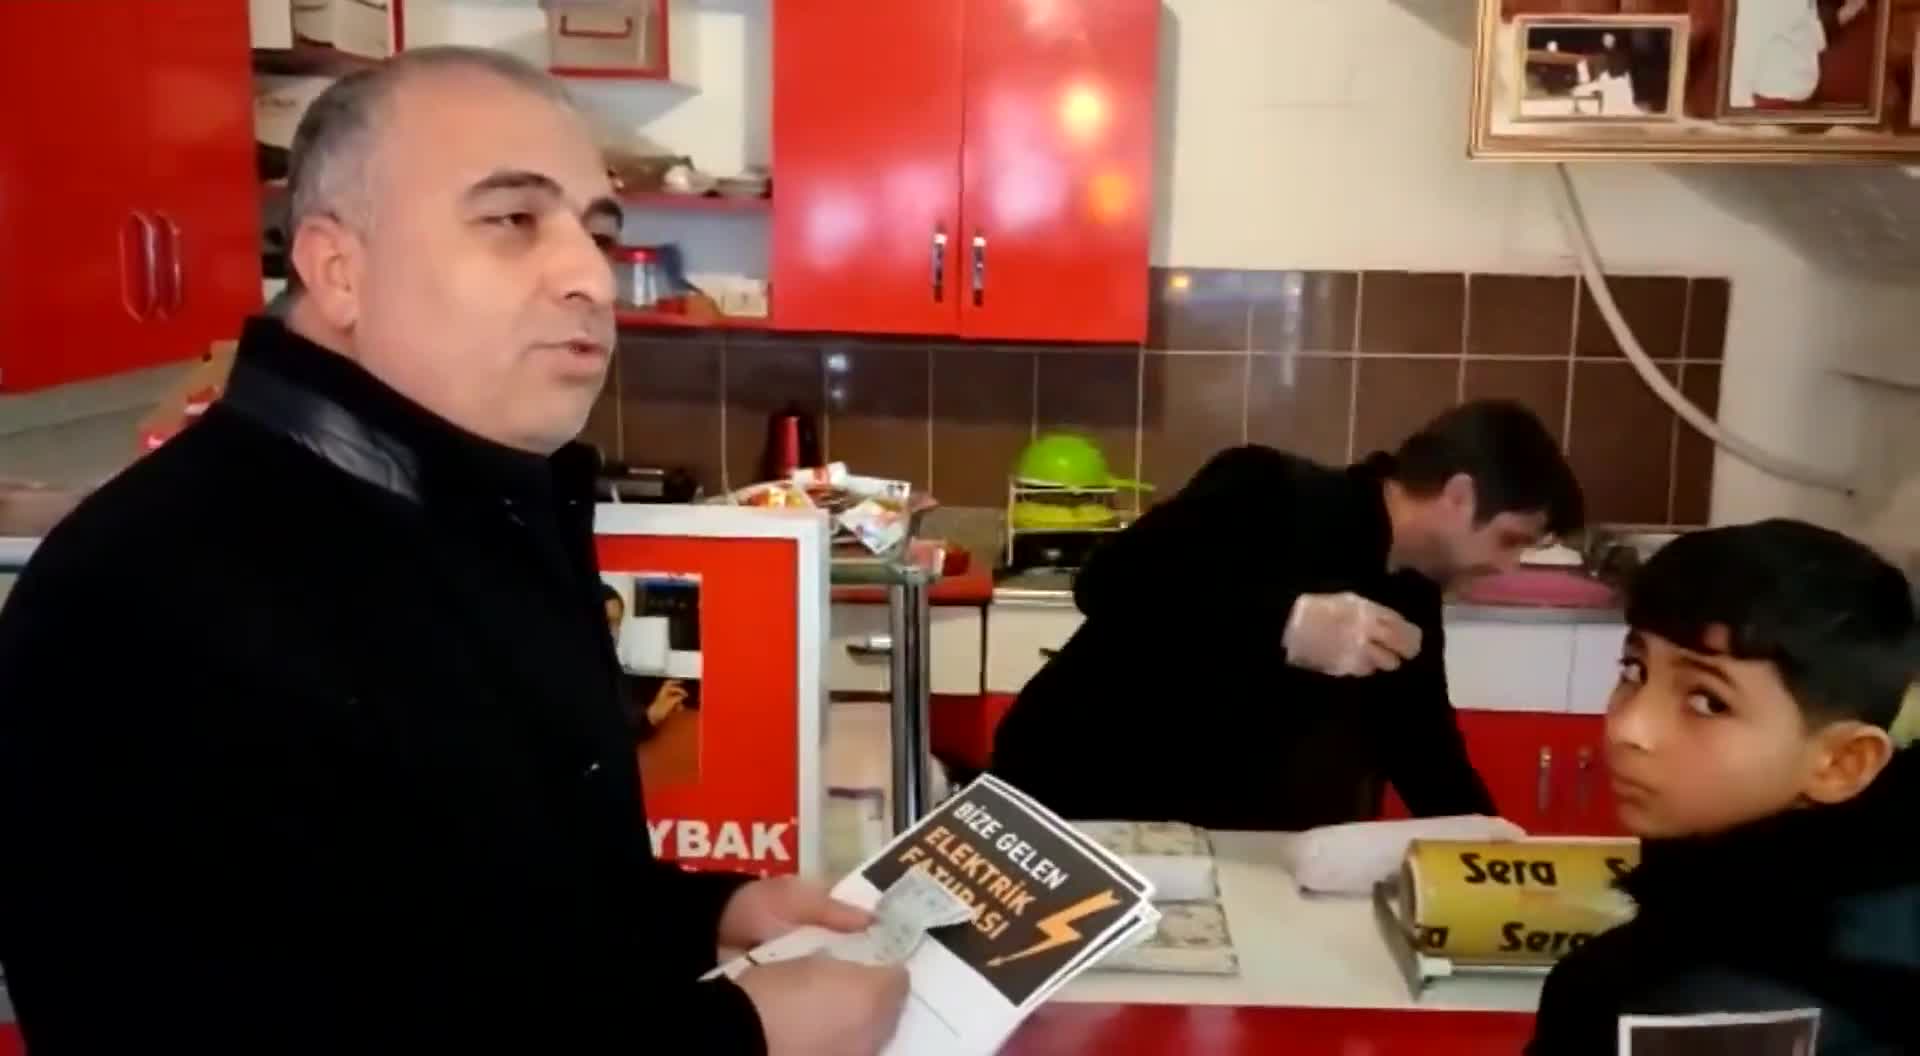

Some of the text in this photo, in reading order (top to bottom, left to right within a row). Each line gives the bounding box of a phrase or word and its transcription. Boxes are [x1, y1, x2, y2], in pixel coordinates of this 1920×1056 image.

[925, 826, 1036, 916] ELEKTRİK
[953, 800, 1068, 890] BİZE GELEN
[1460, 853, 1556, 886] Sera
[1499, 921, 1591, 951] Sera
